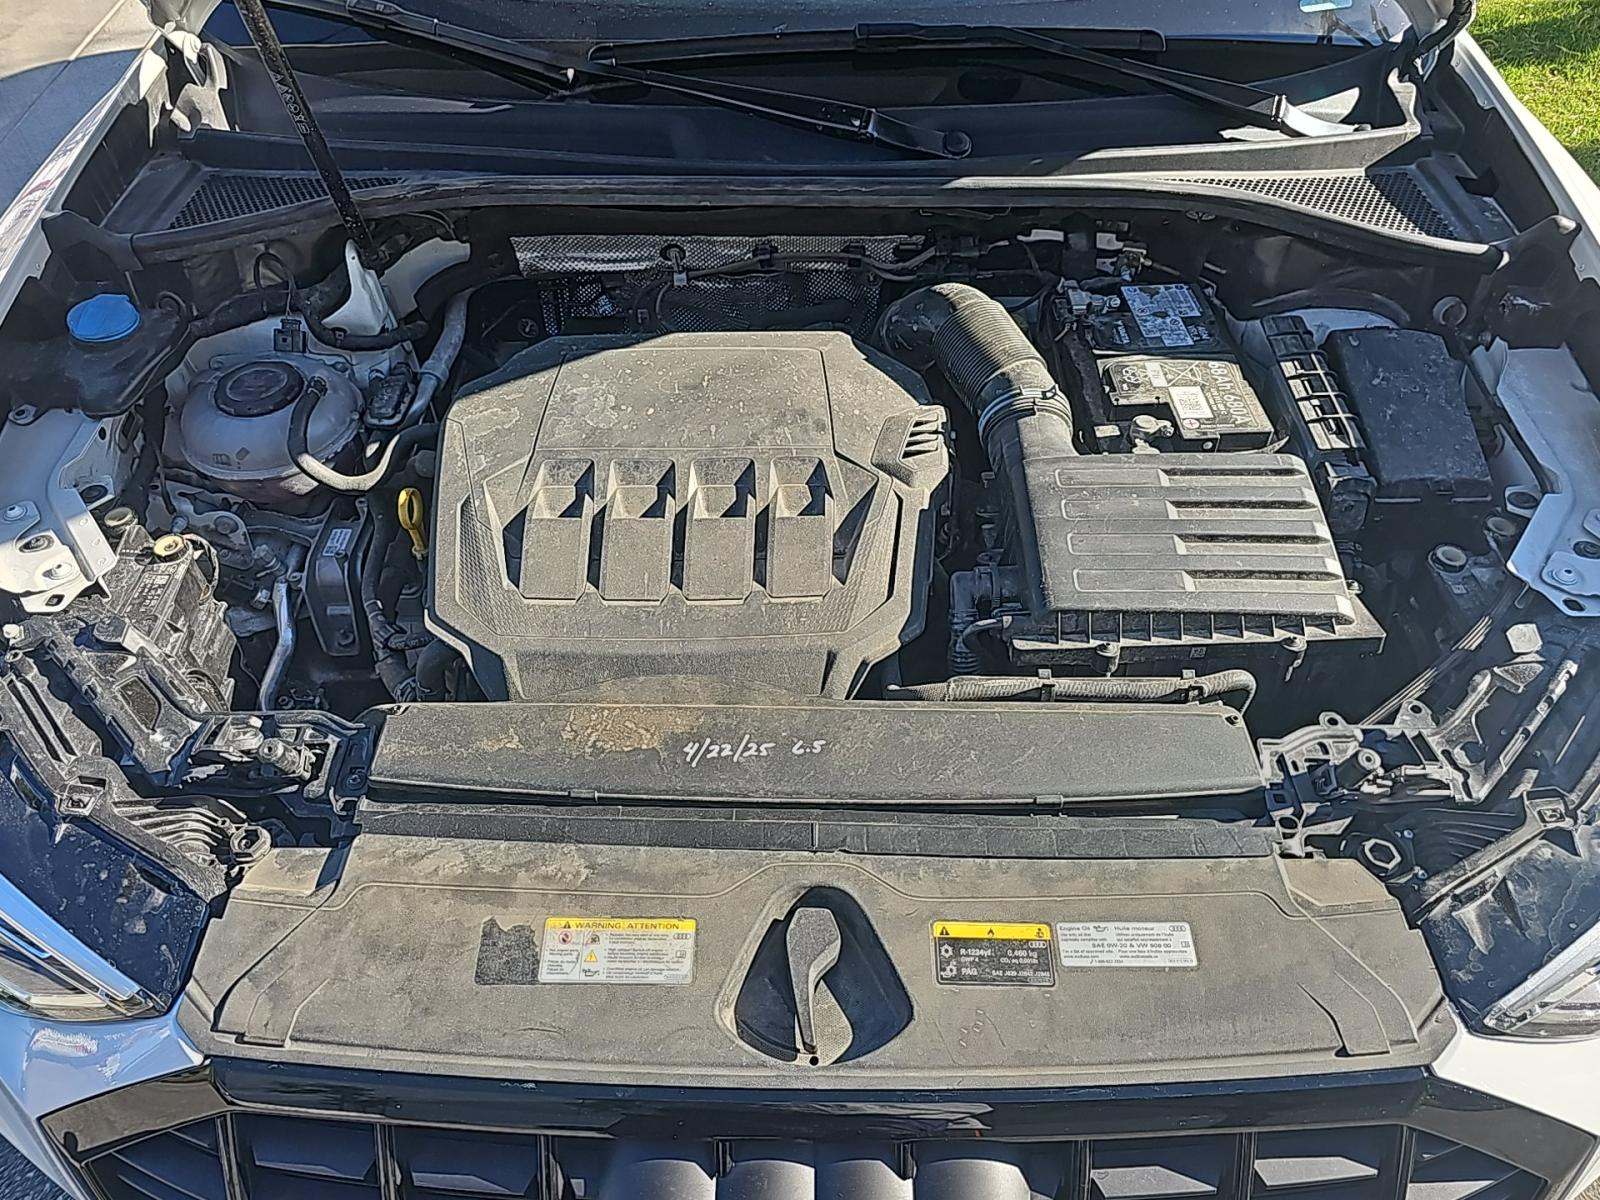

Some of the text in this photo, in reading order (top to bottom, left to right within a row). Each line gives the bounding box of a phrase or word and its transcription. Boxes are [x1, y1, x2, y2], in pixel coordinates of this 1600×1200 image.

[1208, 361, 1234, 390] 68Ah
[1223, 394, 1253, 425] 680A
[683, 734, 776, 767] 4/22/25
[627, 922, 680, 930] ATTENTION
[962, 968, 979, 976] PAG
